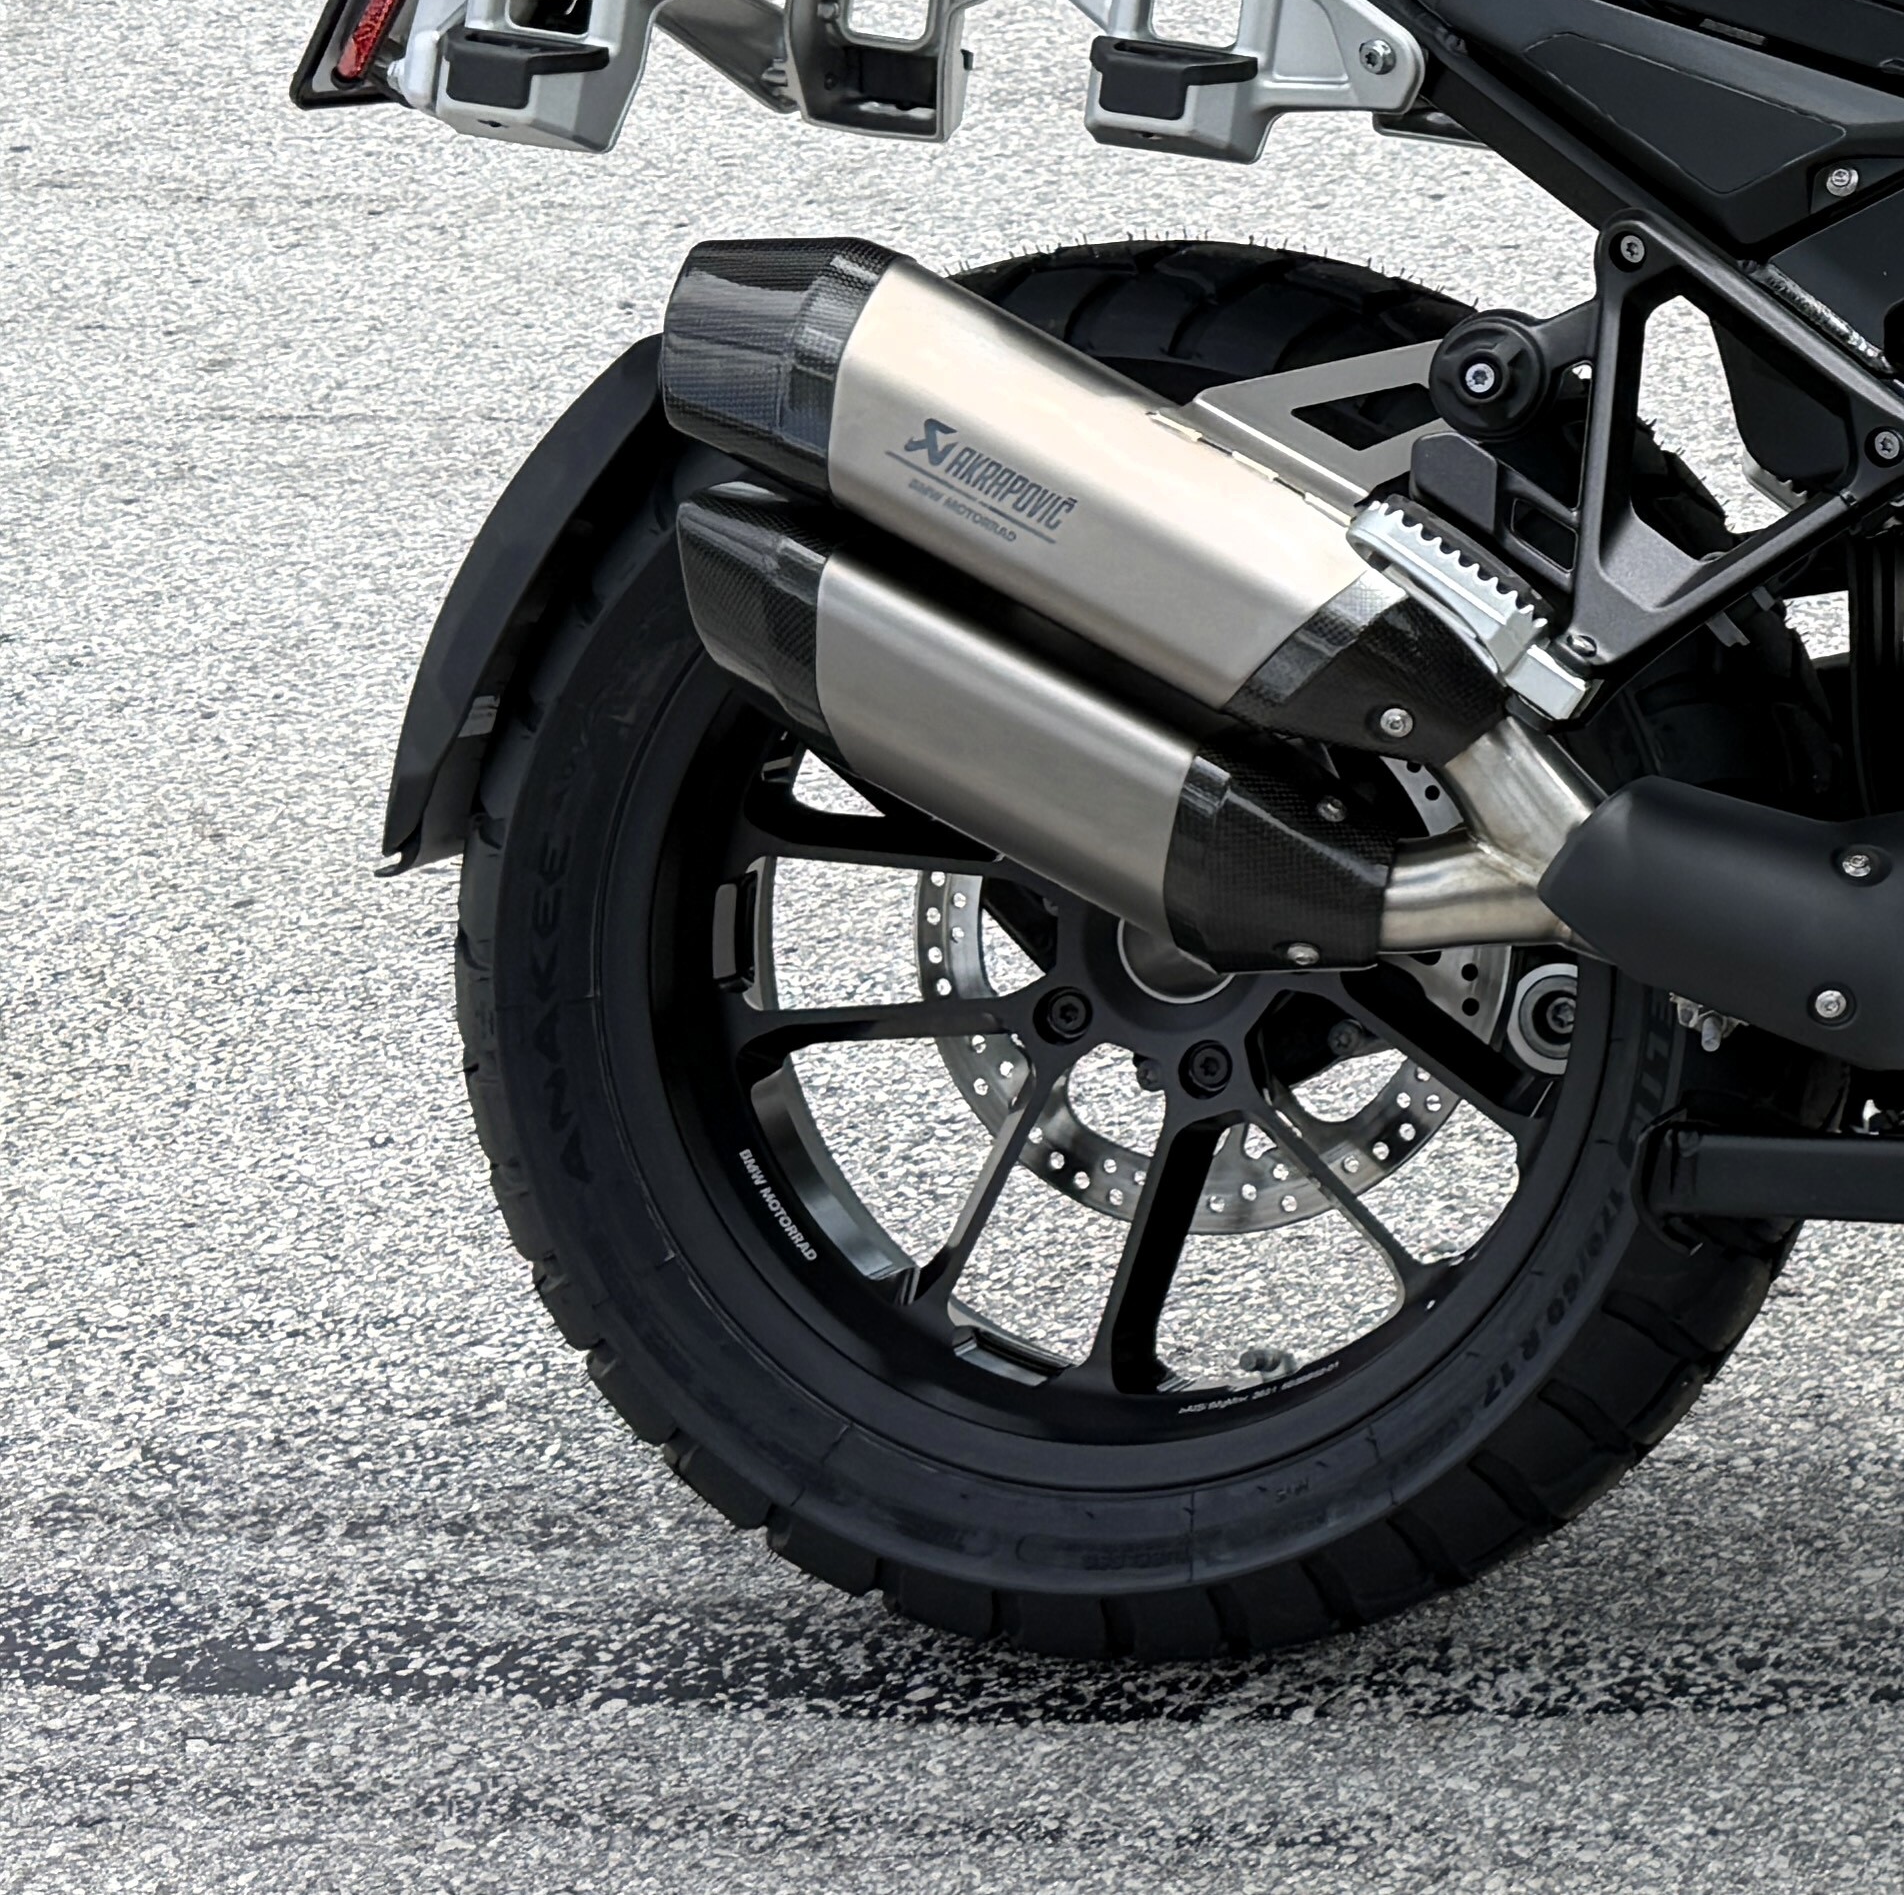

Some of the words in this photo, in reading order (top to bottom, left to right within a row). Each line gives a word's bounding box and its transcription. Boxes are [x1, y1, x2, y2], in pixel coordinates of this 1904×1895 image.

[907, 477, 944, 503] BMW
[940, 497, 1017, 543] MOTORRAD
[739, 1149, 768, 1186] BMW
[760, 1186, 817, 1261] MOTORRAD
